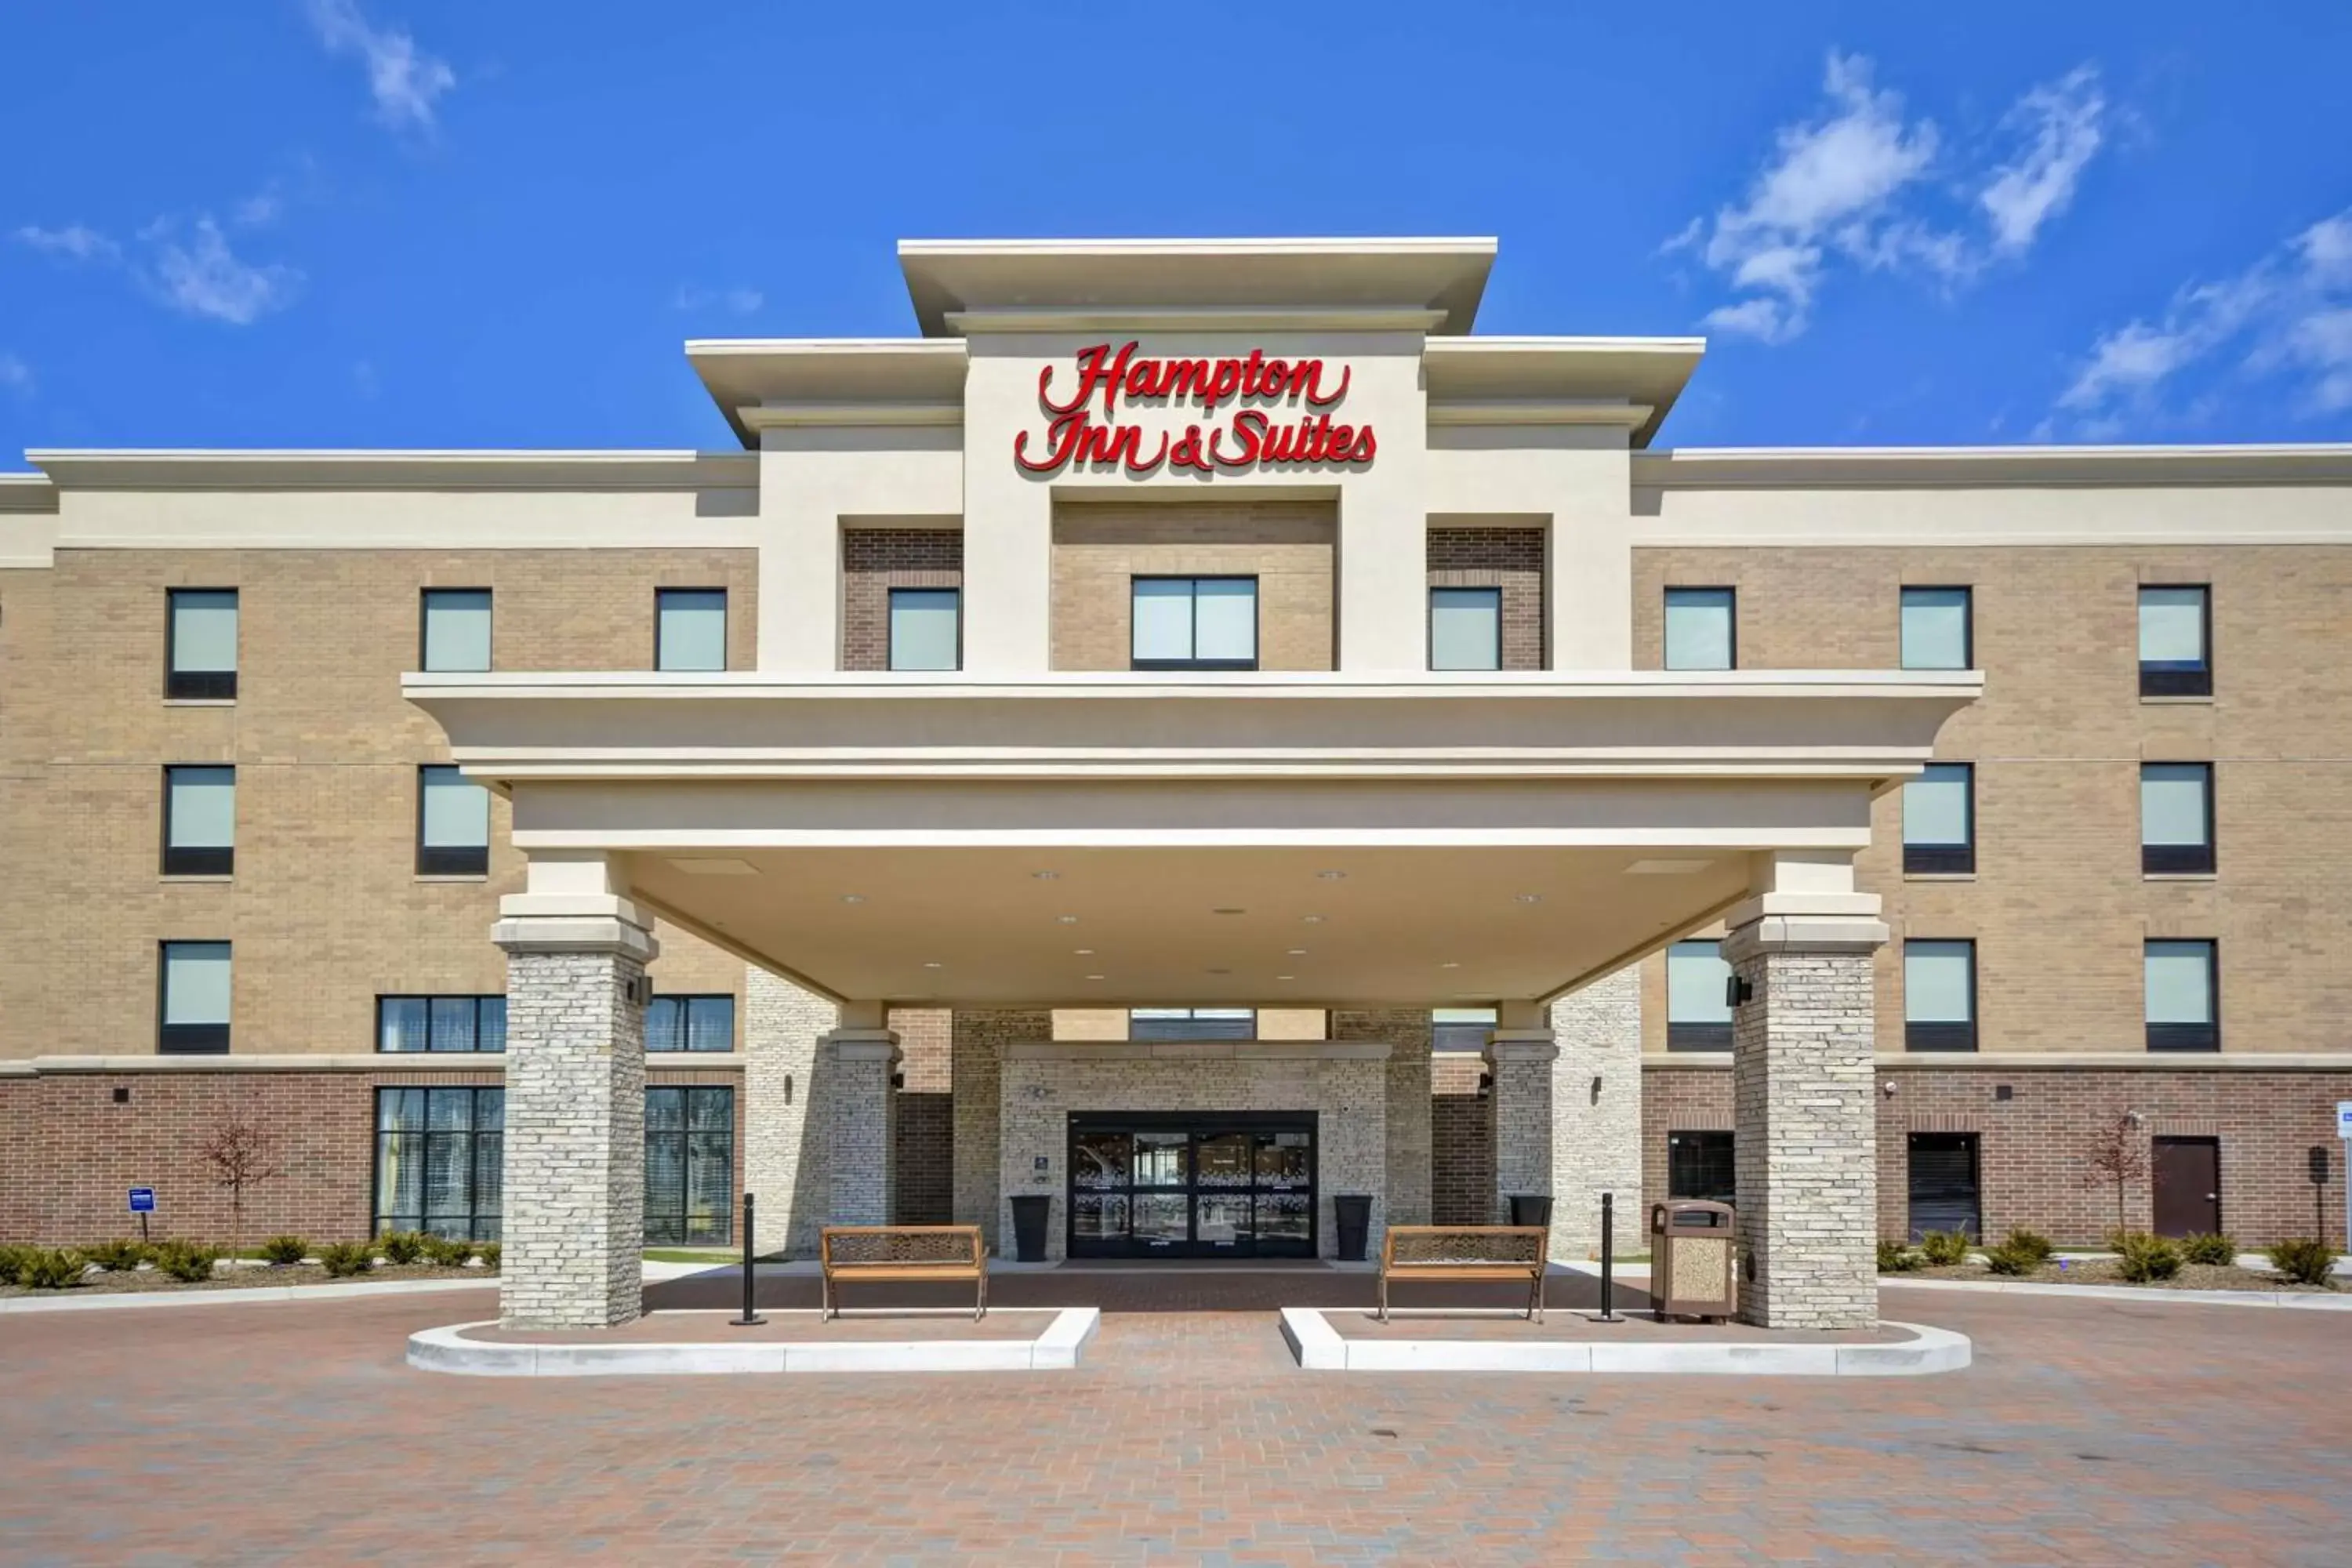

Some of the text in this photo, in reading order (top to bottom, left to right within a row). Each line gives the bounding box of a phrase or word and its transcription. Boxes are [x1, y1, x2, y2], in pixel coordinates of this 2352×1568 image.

[1039, 341, 1351, 414] Hampton
[1014, 410, 1377, 470] Inn & Suites
